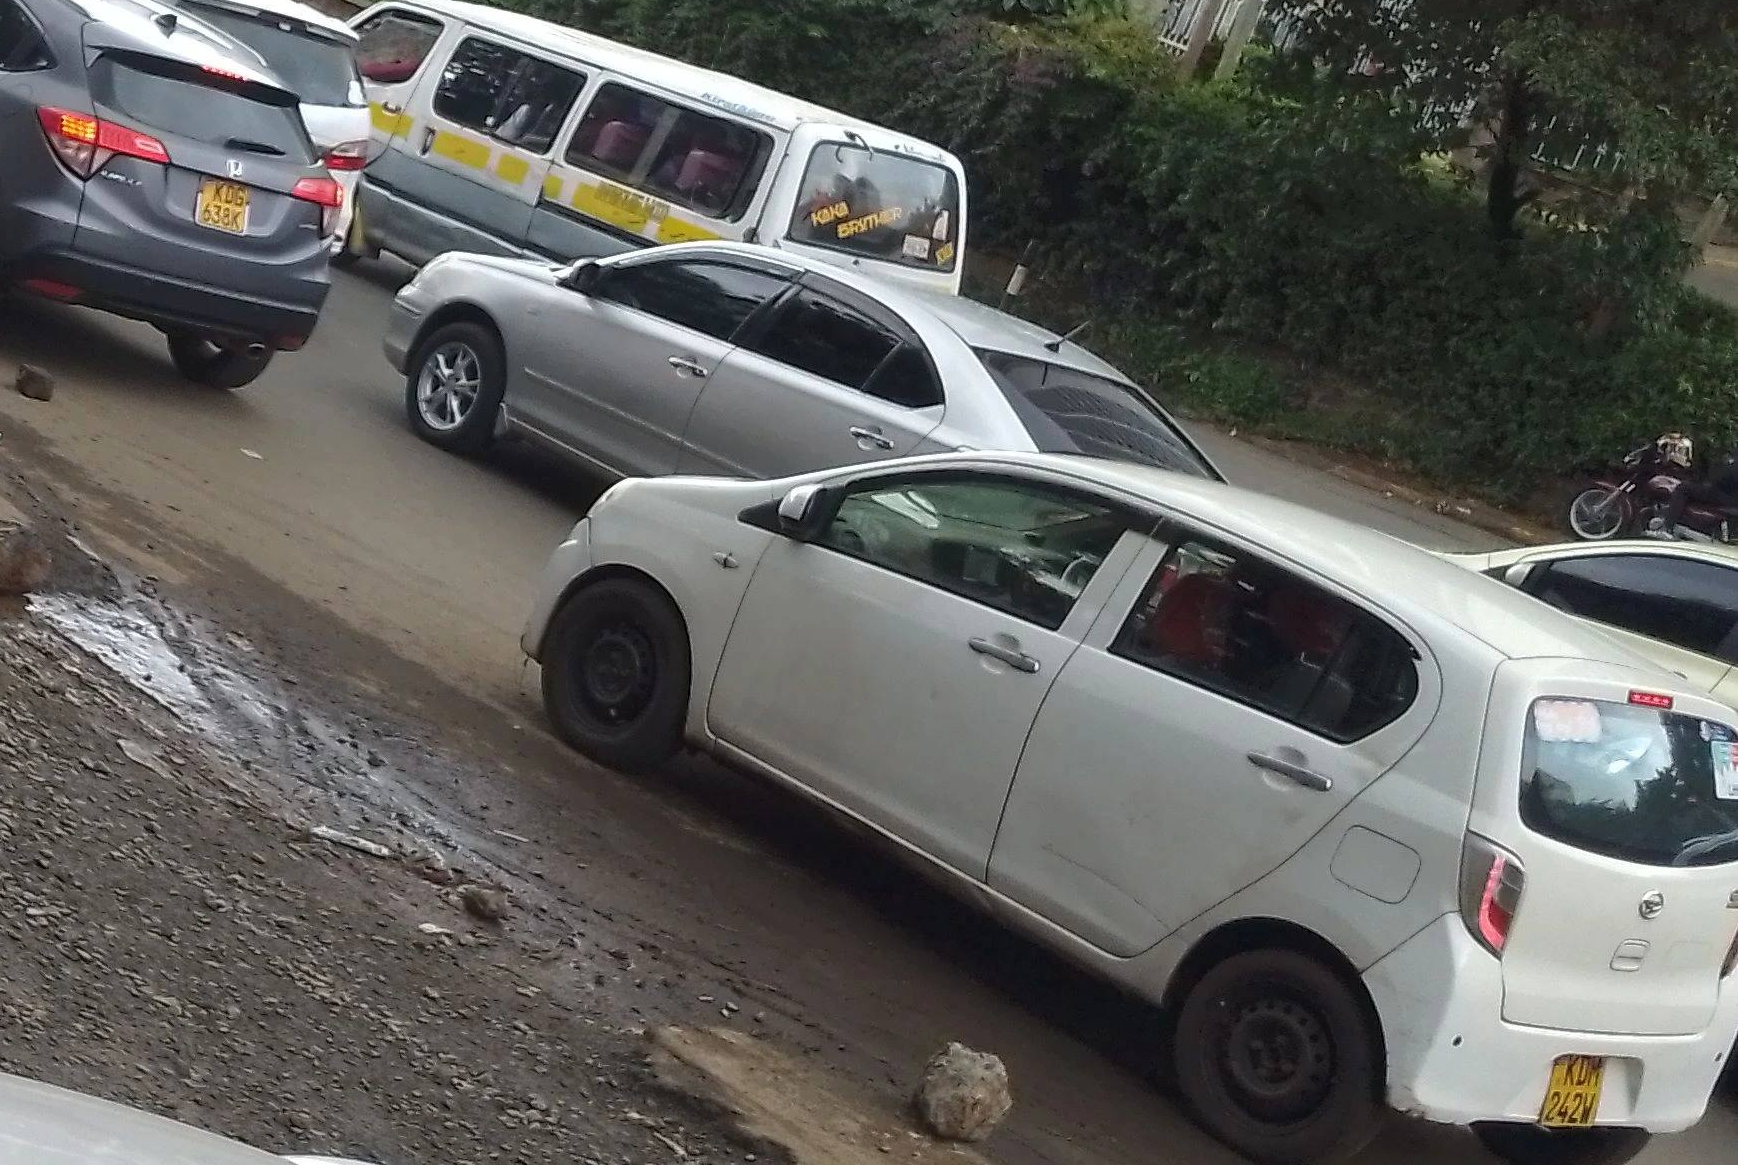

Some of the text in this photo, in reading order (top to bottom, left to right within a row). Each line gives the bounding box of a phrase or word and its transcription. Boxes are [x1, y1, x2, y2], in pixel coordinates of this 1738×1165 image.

[213, 183, 244, 206] KDG
[202, 203, 242, 229] 638K
[1563, 1055, 1602, 1087] KDM
